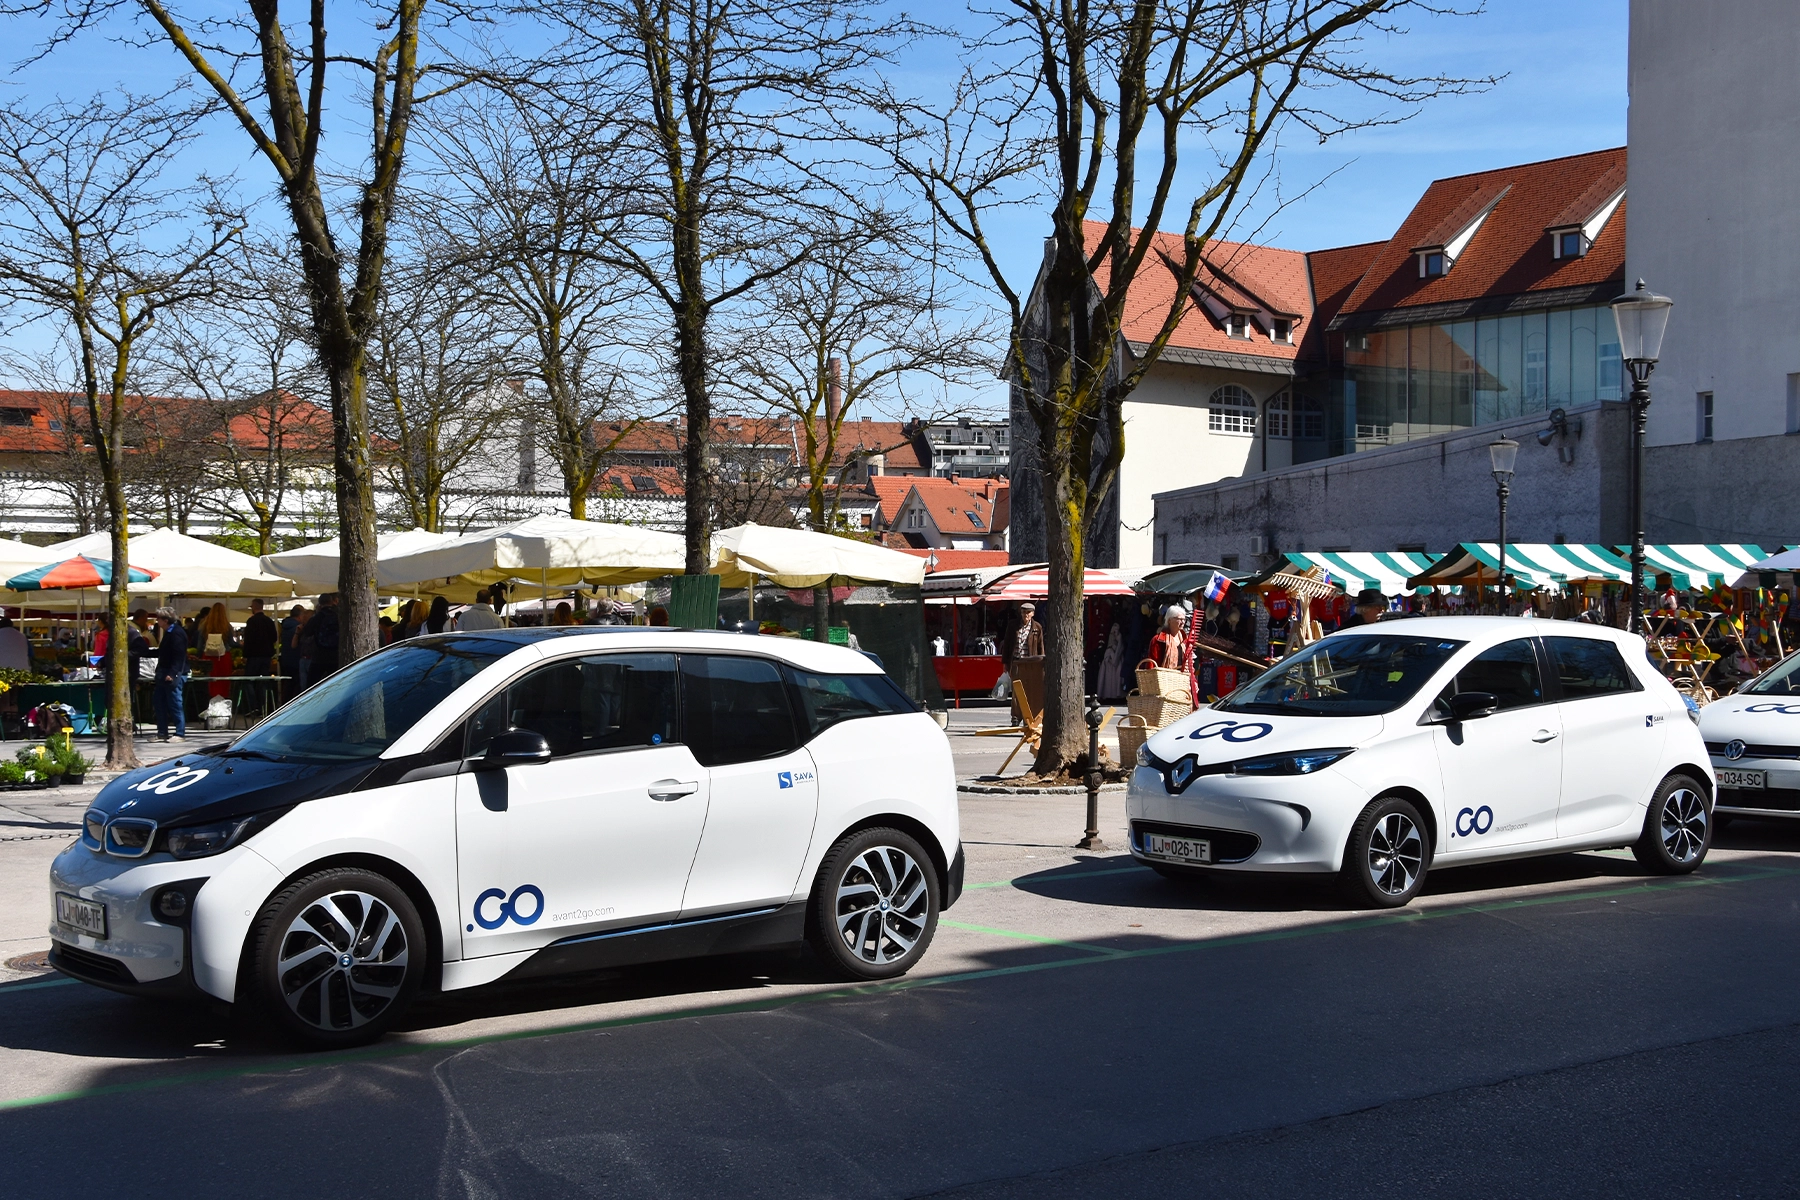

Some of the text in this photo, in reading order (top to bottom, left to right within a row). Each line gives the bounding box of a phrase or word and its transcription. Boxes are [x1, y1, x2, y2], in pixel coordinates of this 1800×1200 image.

[794, 772, 813, 781] SAVA
[1724, 772, 1762, 787] 034-SC
[1152, 837, 1206, 858] LJ 026-TF
[75, 904, 101, 930] 048-TF
[552, 906, 615, 922] avant2go.com
